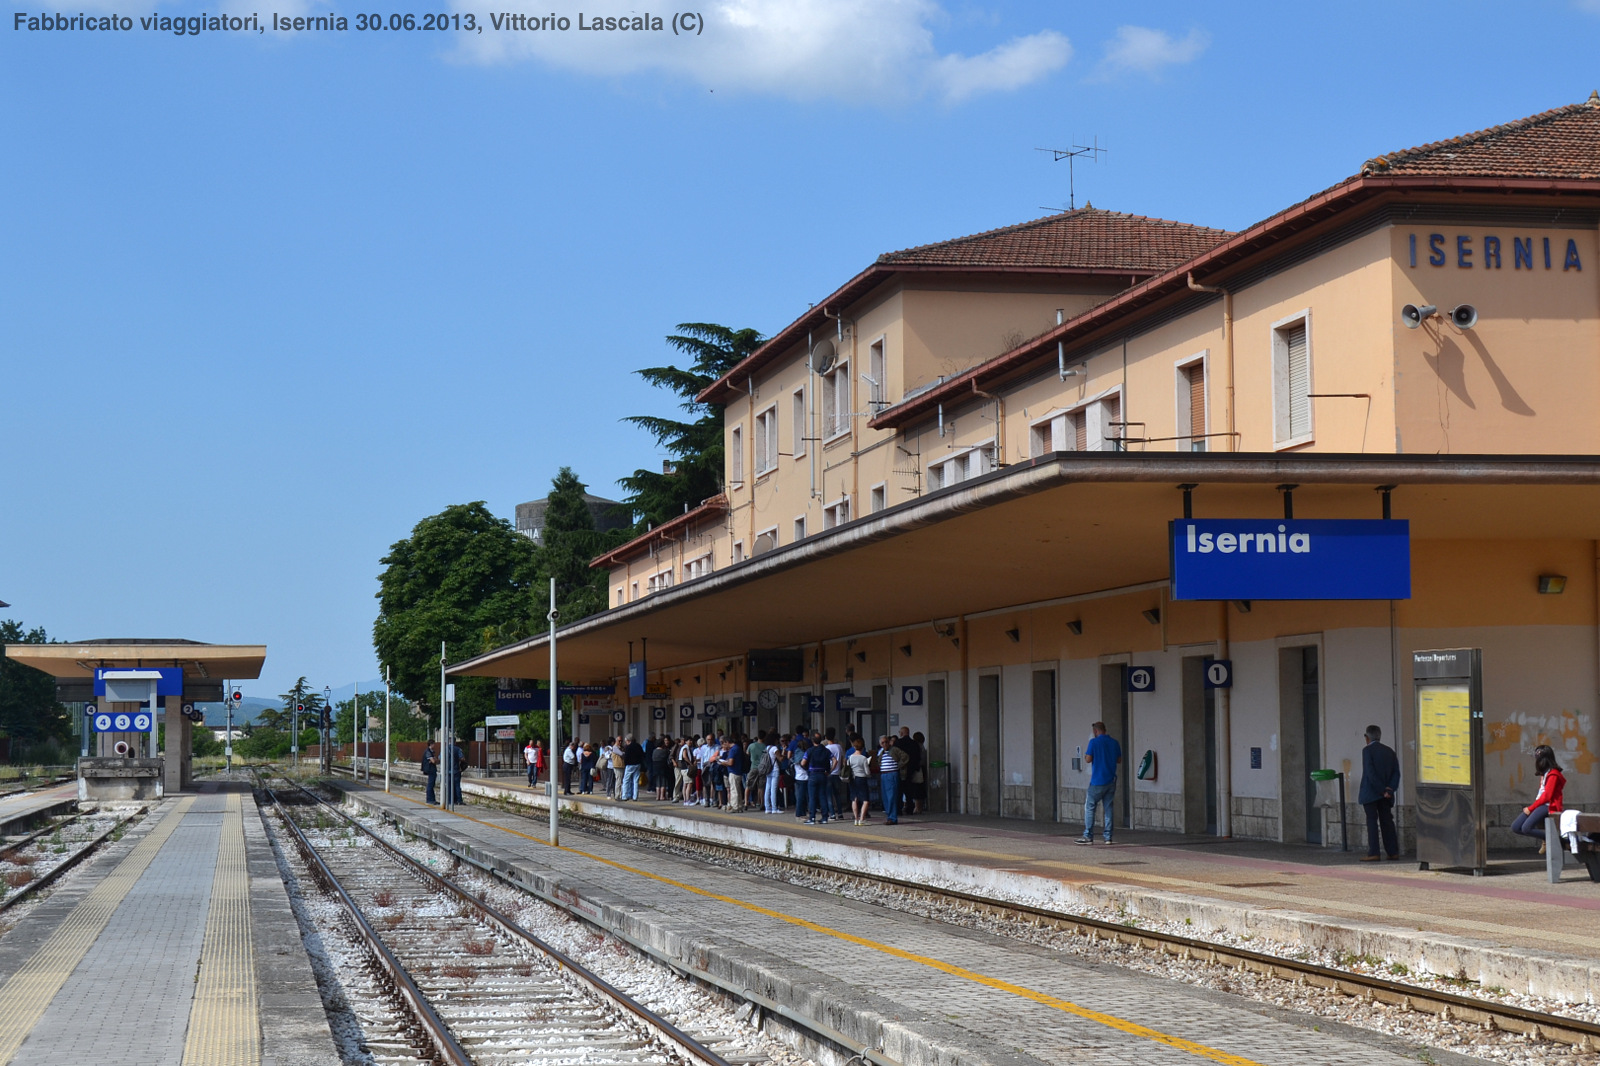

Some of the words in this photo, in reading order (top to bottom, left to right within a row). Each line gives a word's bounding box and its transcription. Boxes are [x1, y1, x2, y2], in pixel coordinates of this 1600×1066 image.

[1409, 234, 1582, 271] ISERNIA
[1187, 524, 1310, 554] Isernia
[1213, 667, 1220, 681] 1
[498, 691, 531, 699] Isernia
[100, 718, 107, 727] 4
[120, 718, 126, 727] 3
[139, 718, 145, 727] 2
